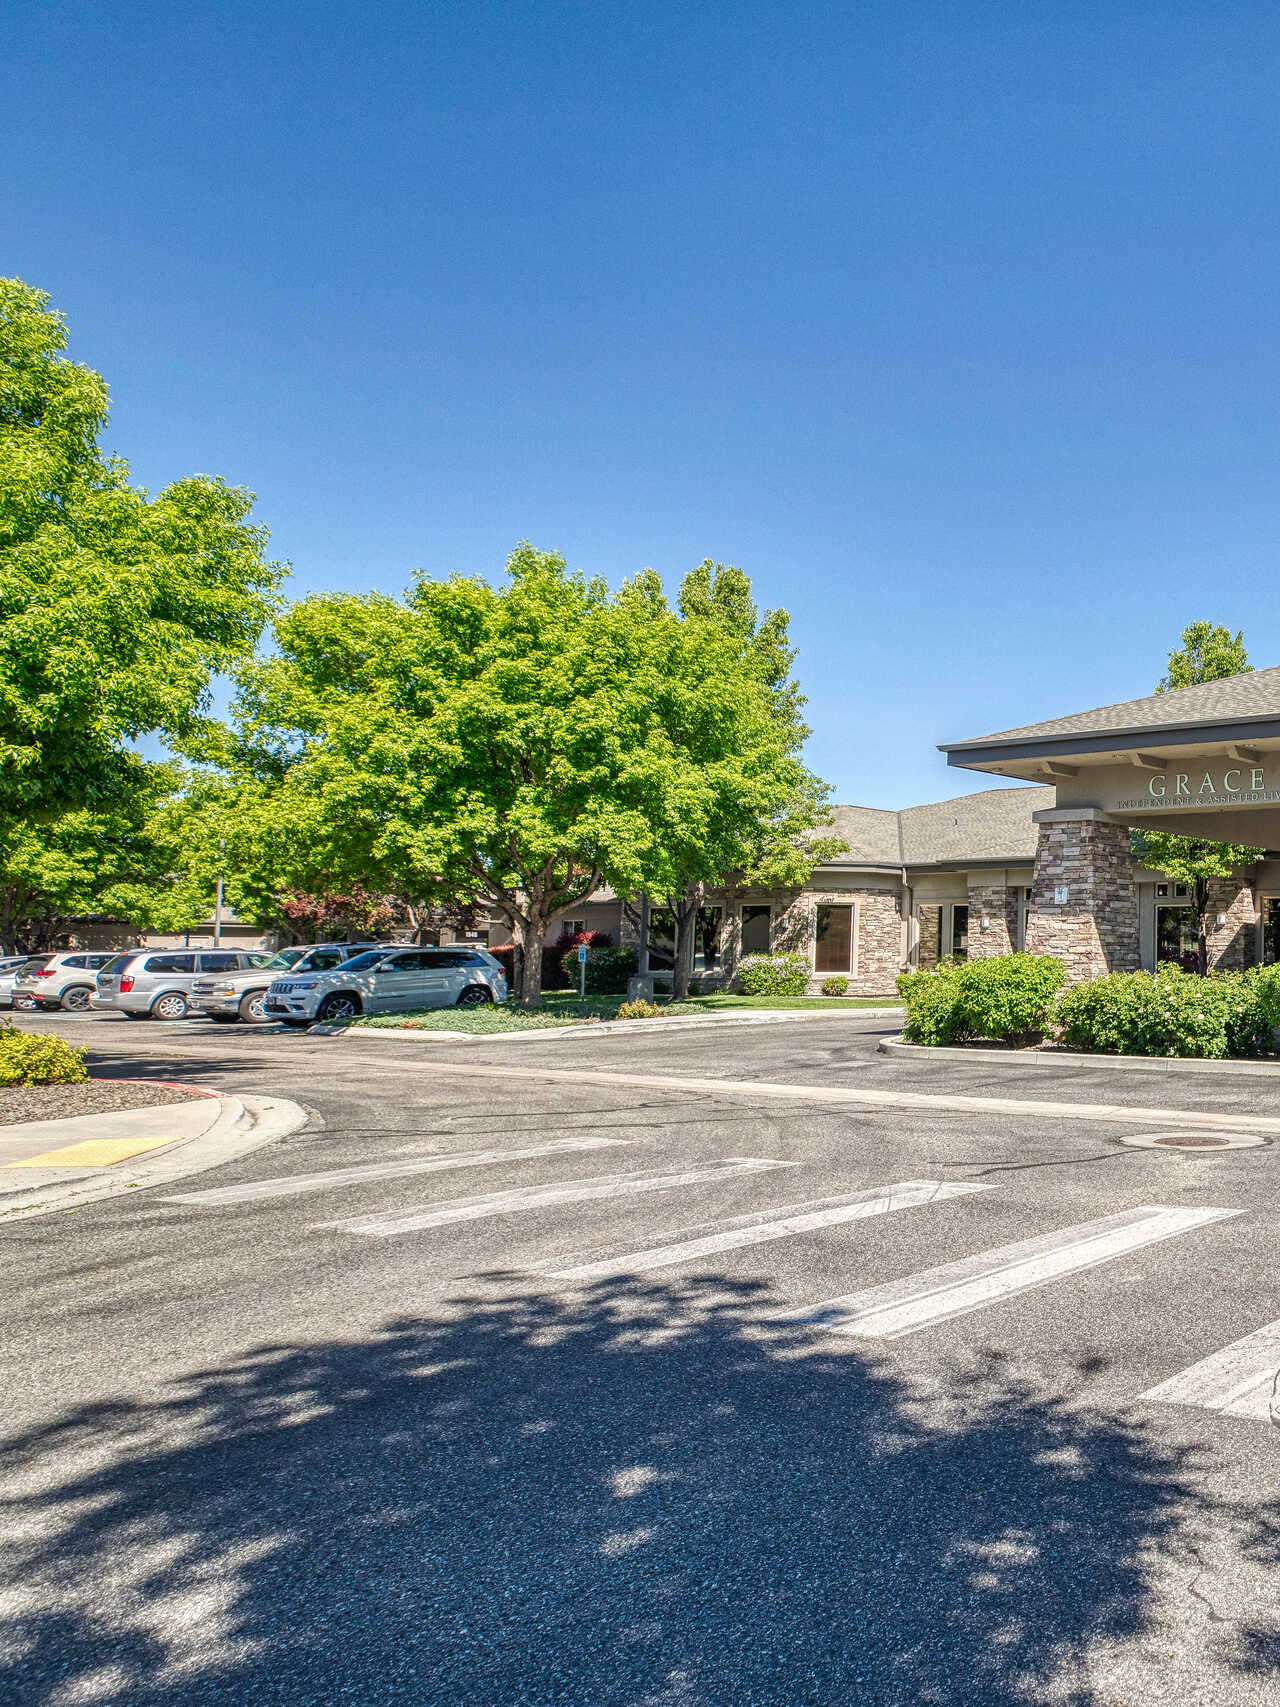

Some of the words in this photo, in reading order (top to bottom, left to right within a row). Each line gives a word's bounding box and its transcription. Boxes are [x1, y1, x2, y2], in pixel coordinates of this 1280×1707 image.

[1148, 767, 1266, 797] GRACE
[1118, 797, 1192, 809] INDEPENDENT
[1208, 792, 1258, 805] ASSISTED
